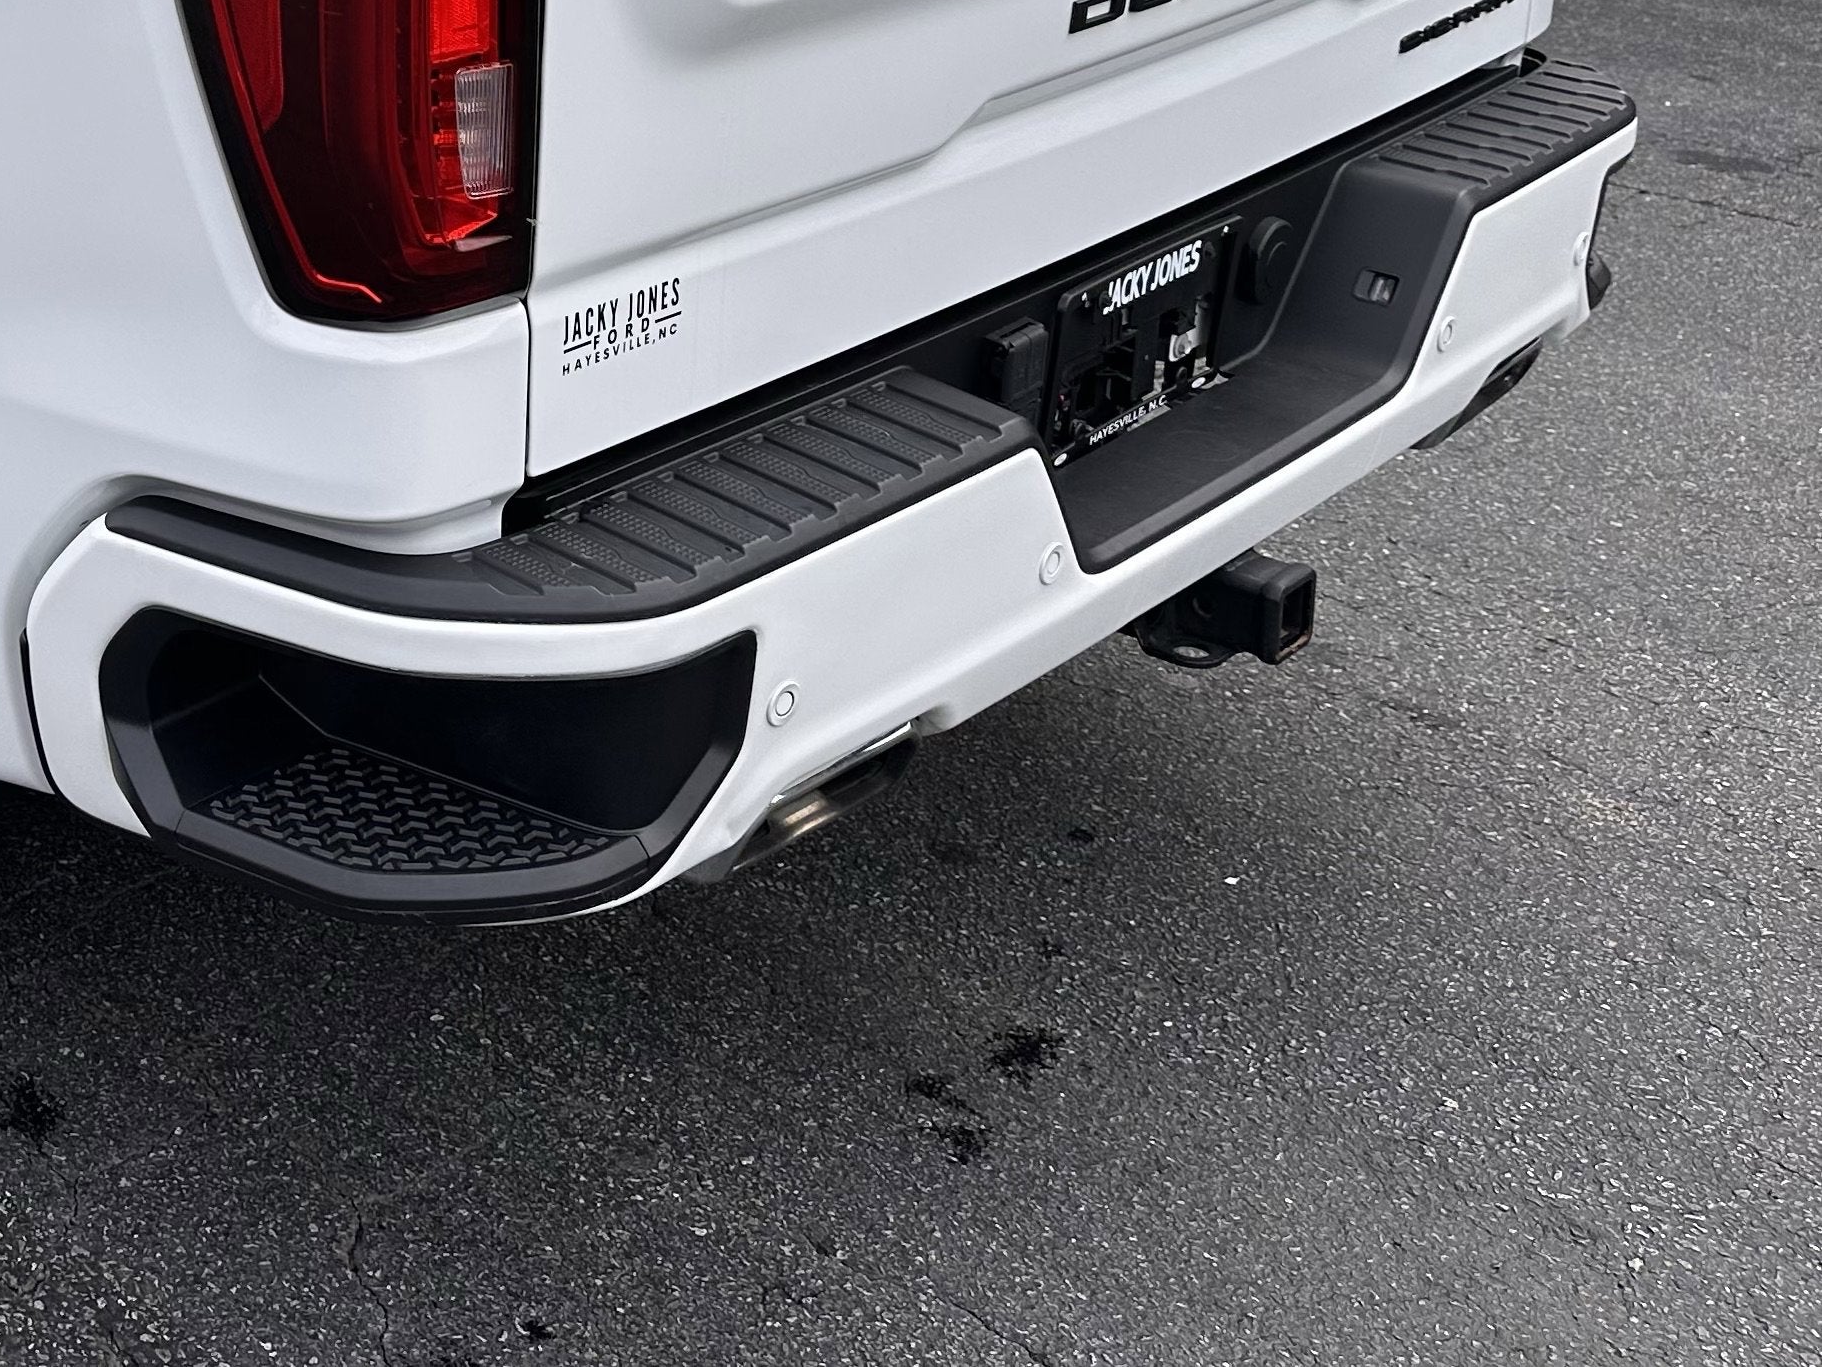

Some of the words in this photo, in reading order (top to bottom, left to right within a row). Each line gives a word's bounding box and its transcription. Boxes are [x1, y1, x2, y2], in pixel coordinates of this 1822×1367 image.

[1103, 262, 1153, 315] JACKY
[1150, 240, 1202, 291] JONES
[564, 298, 618, 345] JACKY
[628, 278, 679, 322] JONES
[594, 318, 649, 350] FORD
